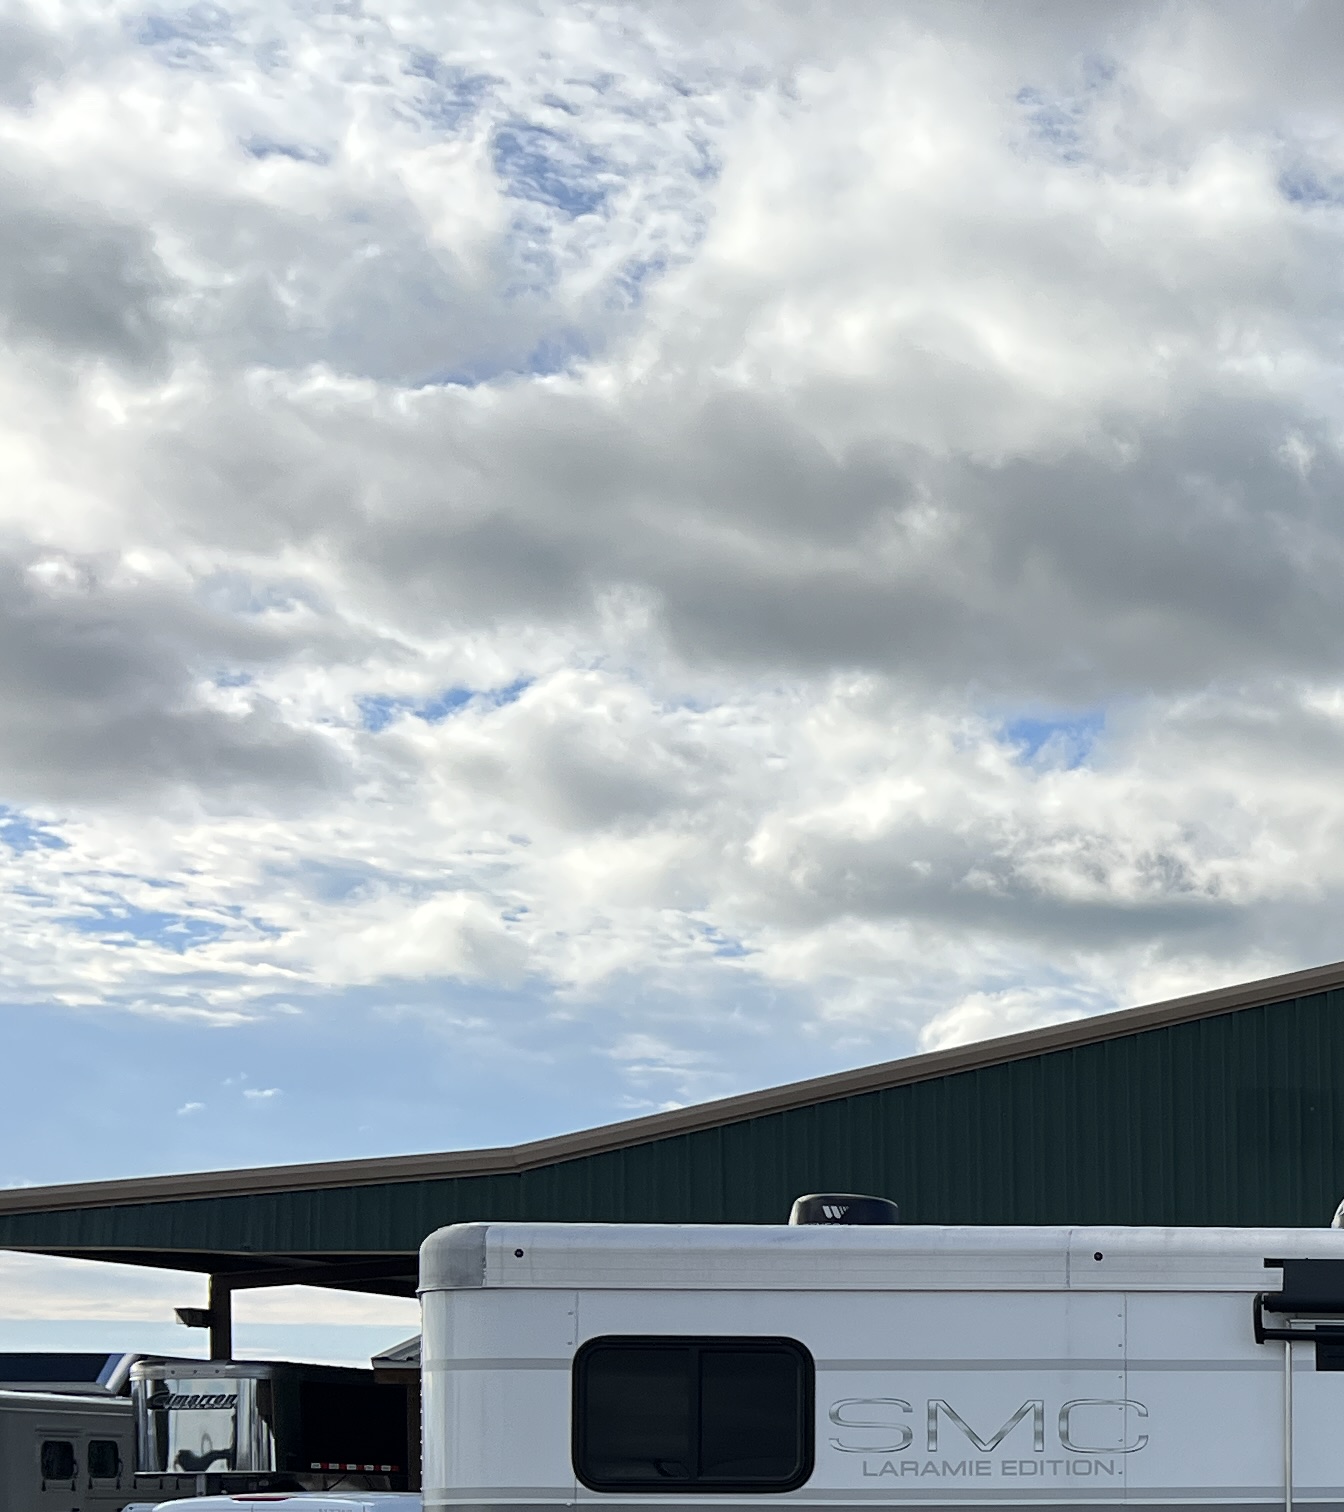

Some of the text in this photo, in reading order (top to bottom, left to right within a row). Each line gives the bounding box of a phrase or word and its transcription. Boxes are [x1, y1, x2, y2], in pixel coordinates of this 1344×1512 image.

[828, 1397, 1150, 1454] SMC
[862, 1459, 1115, 1477] LARAMIE EDITION
